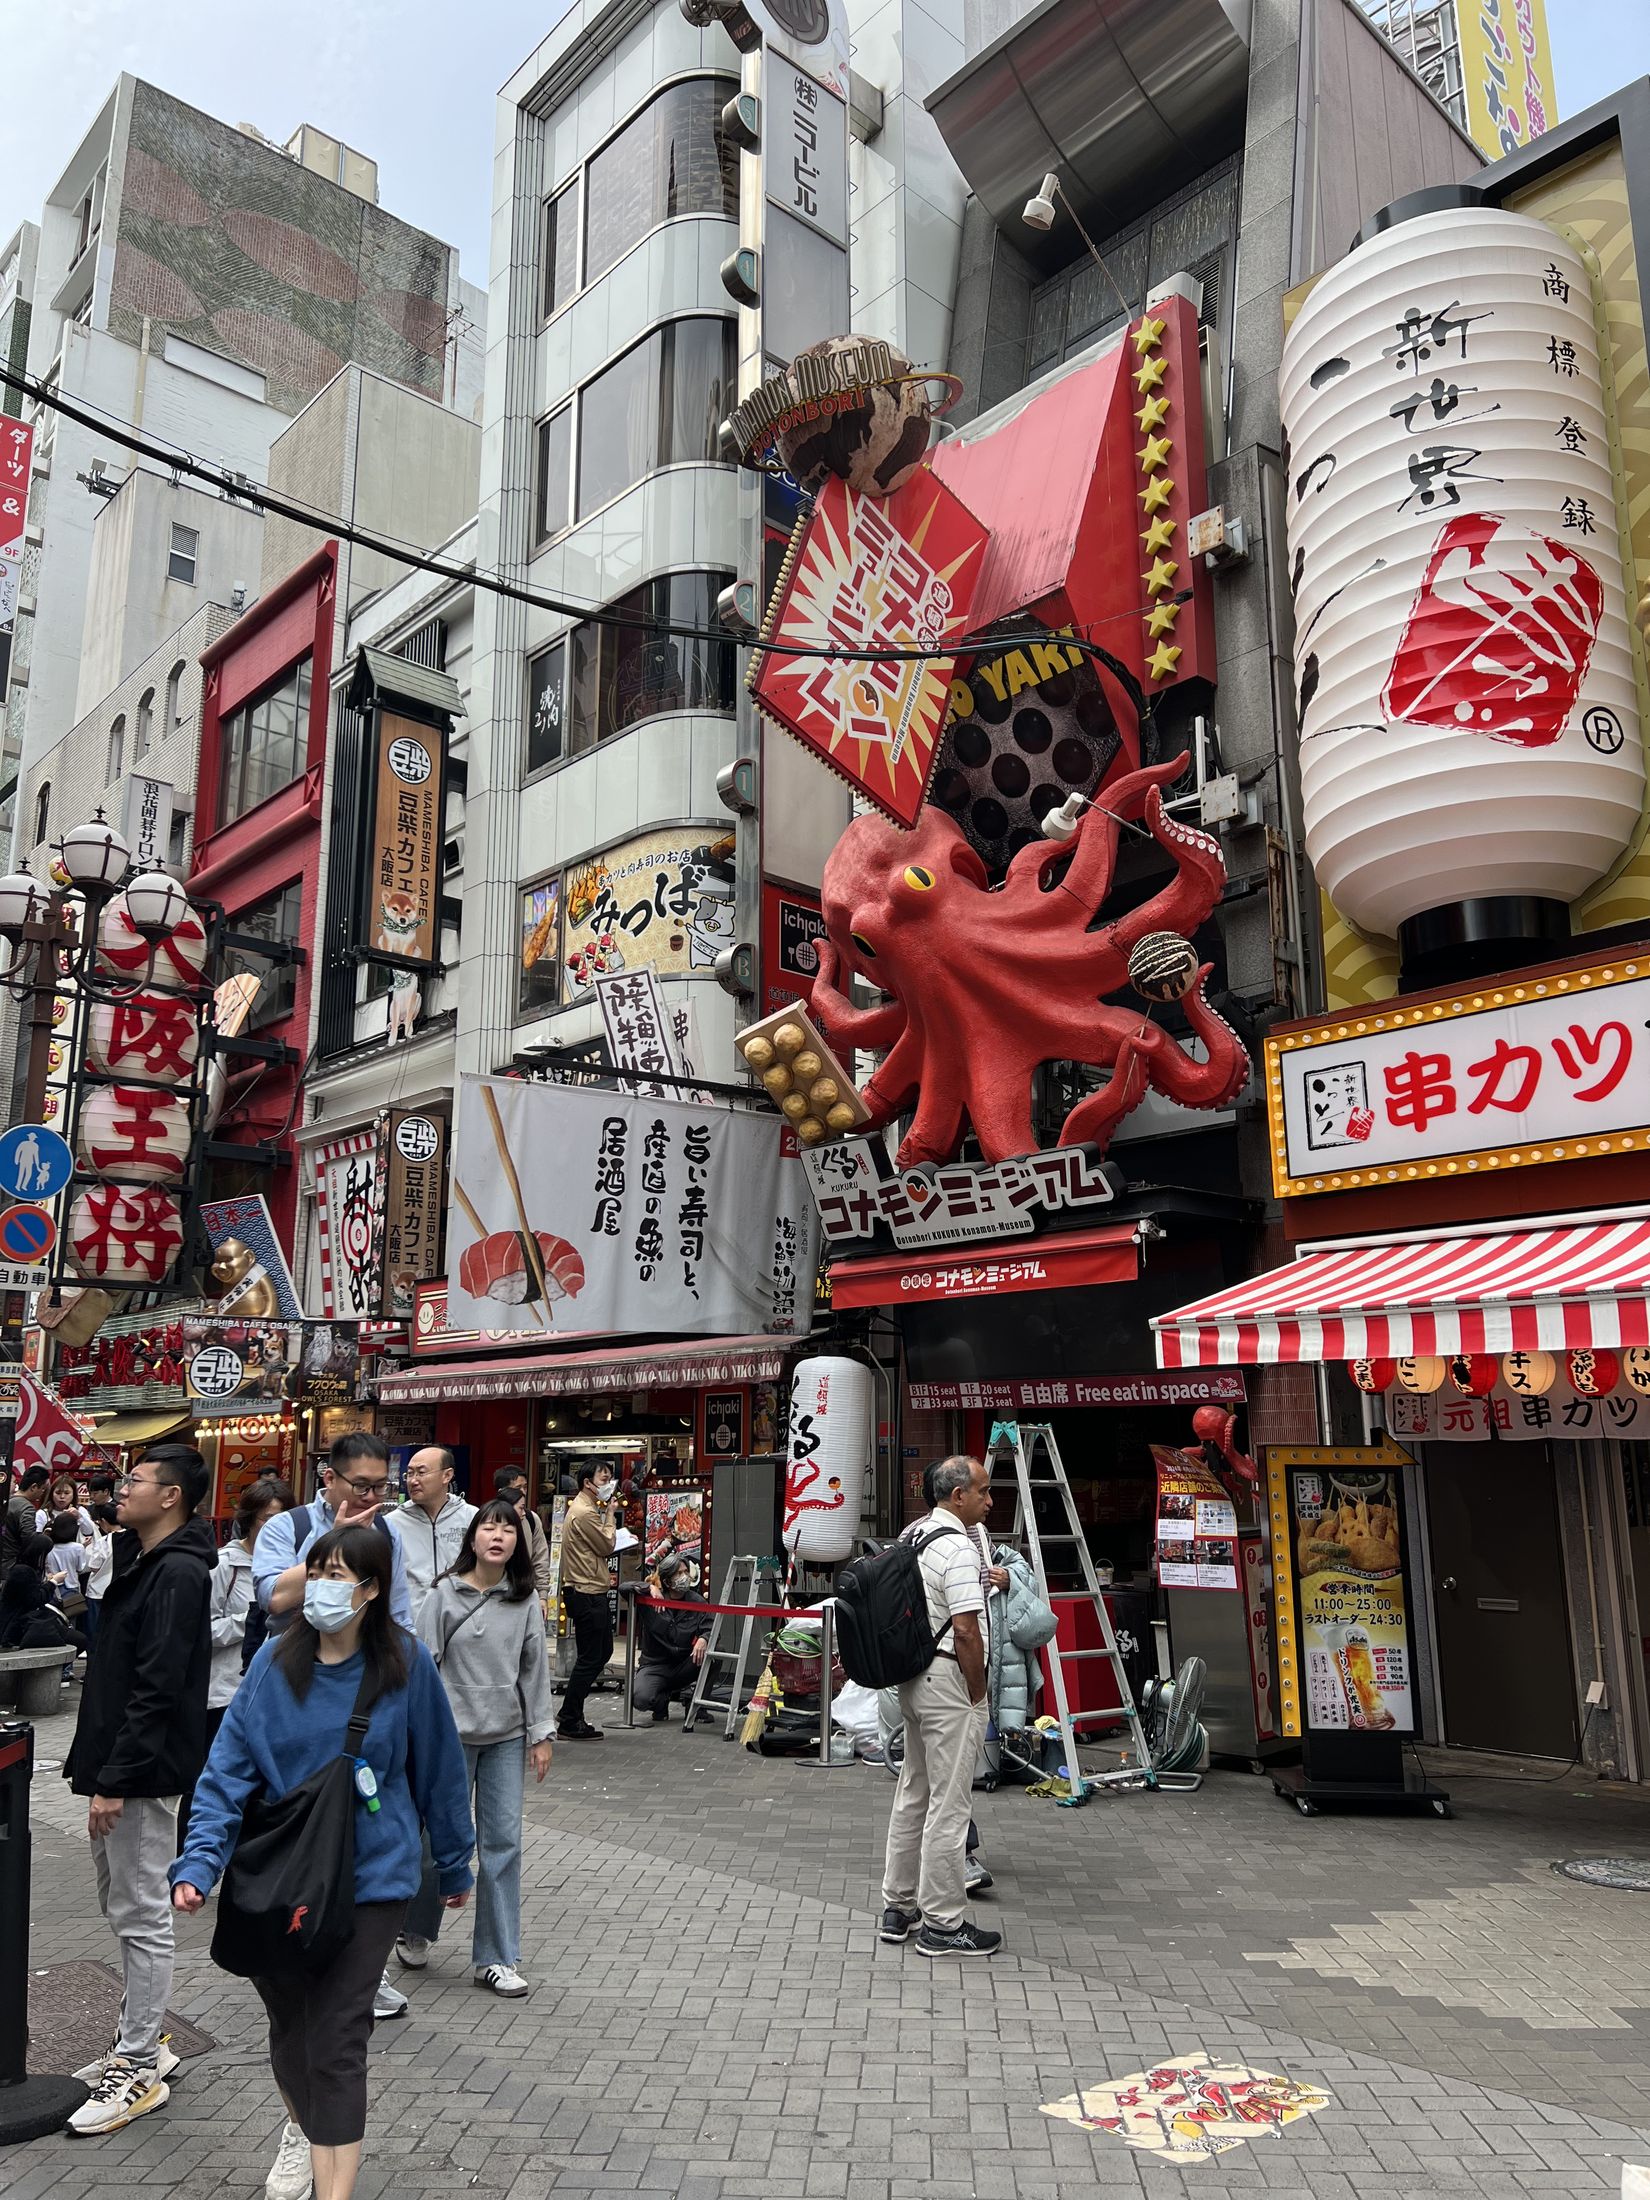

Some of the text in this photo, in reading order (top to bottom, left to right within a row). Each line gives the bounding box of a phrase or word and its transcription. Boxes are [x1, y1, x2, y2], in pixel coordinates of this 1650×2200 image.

[793, 341, 893, 404] MUSEUM
[1382, 300, 1505, 517] 新世界
[1543, 262, 1596, 537] 商標登録
[7, 427, 29, 478] ダーツ
[3, 497, 21, 517] &
[5, 546, 19, 559] 9F
[977, 623, 1087, 703] YAKI
[138, 781, 160, 866] 浪花囲碁サロン
[398, 789, 418, 894] 豆柴カフェ
[381, 845, 396, 889] 大阪店
[418, 788, 433, 918] MAMESHIBA CAFE
[590, 864, 706, 938] みつば
[1383, 1020, 1633, 1133] 串カツ
[591, 1116, 628, 1236] 居酒屋
[820, 1145, 859, 1181] くくる
[426, 1161, 439, 1245] MAMESHIBA
[634, 1118, 671, 1282] 産直の魚の
[819, 1155, 1108, 1236] コナモンミュージアム
[831, 1181, 859, 1194] KUKURU
[404, 1165, 424, 1266] 豆柴カフェ
[896, 1219, 1032, 1245] Dotonbori KUKURU Konamon-Museum
[389, 1224, 402, 1264] 大阪店
[935, 1261, 1047, 1289] コナモンミュージアム
[186, 1317, 301, 1331] MAMESHIBA CAFE OSAKA
[909, 1384, 929, 1396] B1F
[929, 1385, 939, 1396] 15
[940, 1384, 957, 1396] seat
[981, 1384, 992, 1394] 20
[993, 1384, 1011, 1394] seat
[1508, 1351, 1532, 1390] キス
[323, 1395, 353, 1403] FOREST
[930, 1397, 941, 1408] 33
[942, 1397, 958, 1408] seat
[983, 1396, 994, 1406] 25
[995, 1395, 1013, 1407] seat
[1020, 1383, 1069, 1404] 自由席
[1076, 1383, 1113, 1403] Free
[1113, 1383, 1139, 1401] eat
[1141, 1381, 1159, 1400] in
[1160, 1381, 1210, 1404] space
[388, 1417, 436, 1430] 豆柴カフェ
[1327, 1583, 1375, 1595] 営業時間
[1349, 1636, 1368, 1644] Asahi
[1338, 1648, 1362, 1715] ドリンクが充実
